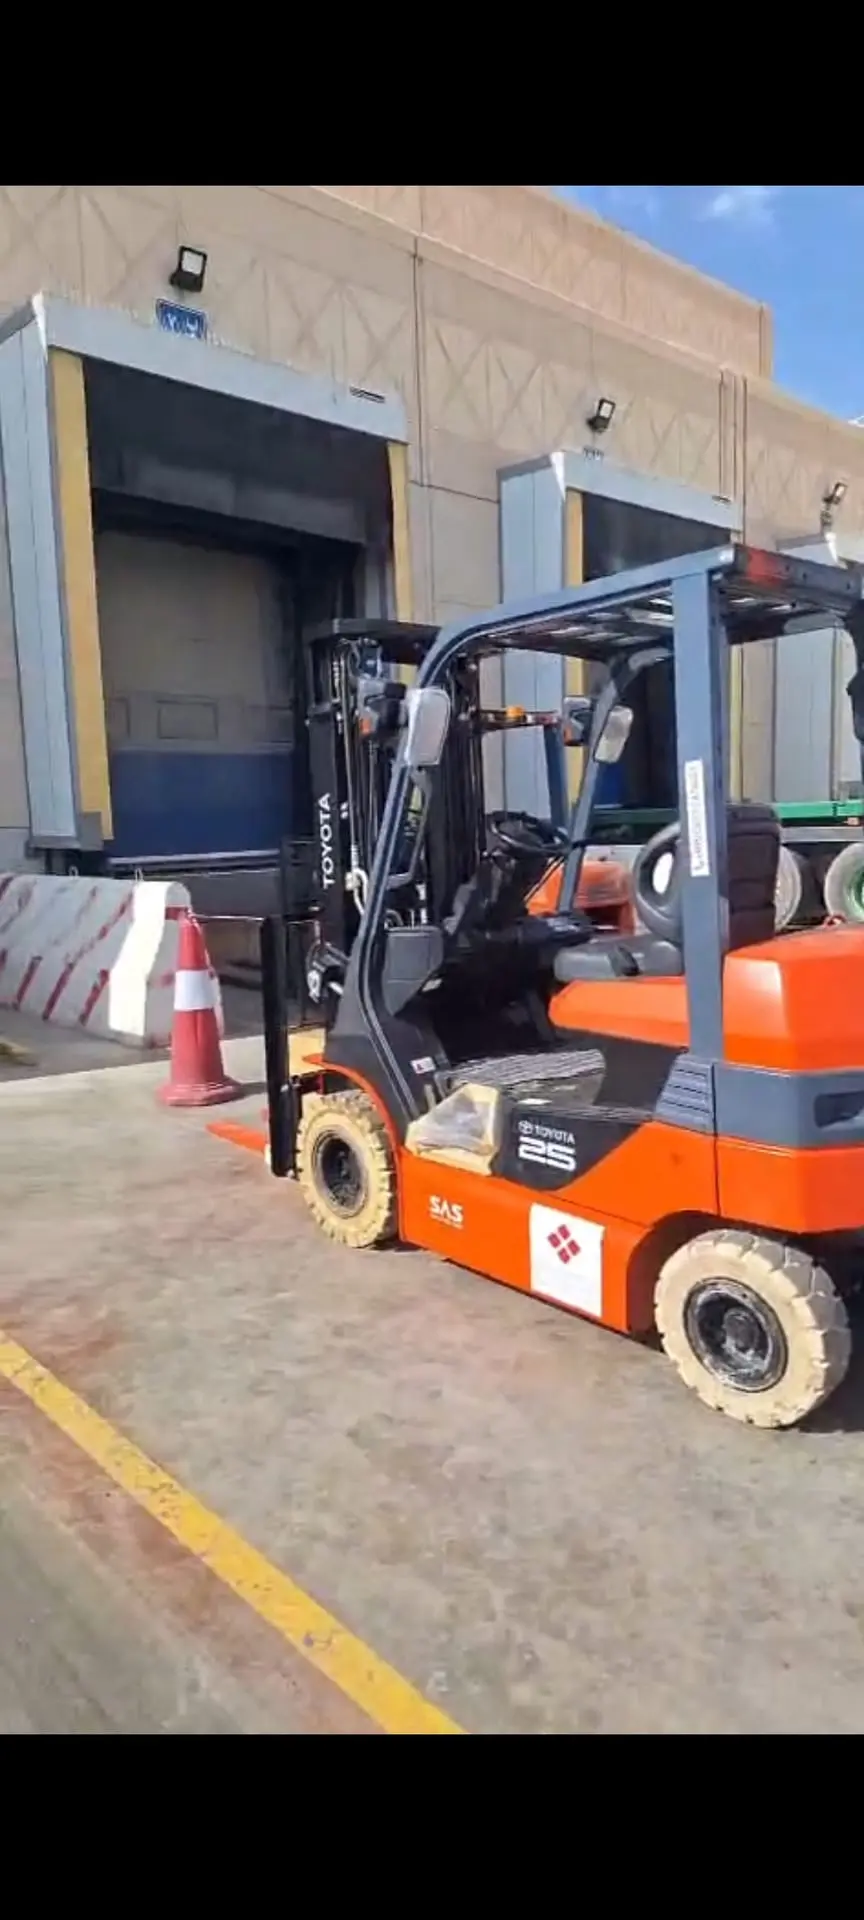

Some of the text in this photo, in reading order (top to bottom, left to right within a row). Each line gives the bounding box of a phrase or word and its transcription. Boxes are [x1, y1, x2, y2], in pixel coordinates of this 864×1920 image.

[318, 792, 335, 889] TOYOTA
[535, 1125, 575, 1145] TOYOTA
[519, 1135, 576, 1171] 25
[430, 1195, 463, 1222] SAS
